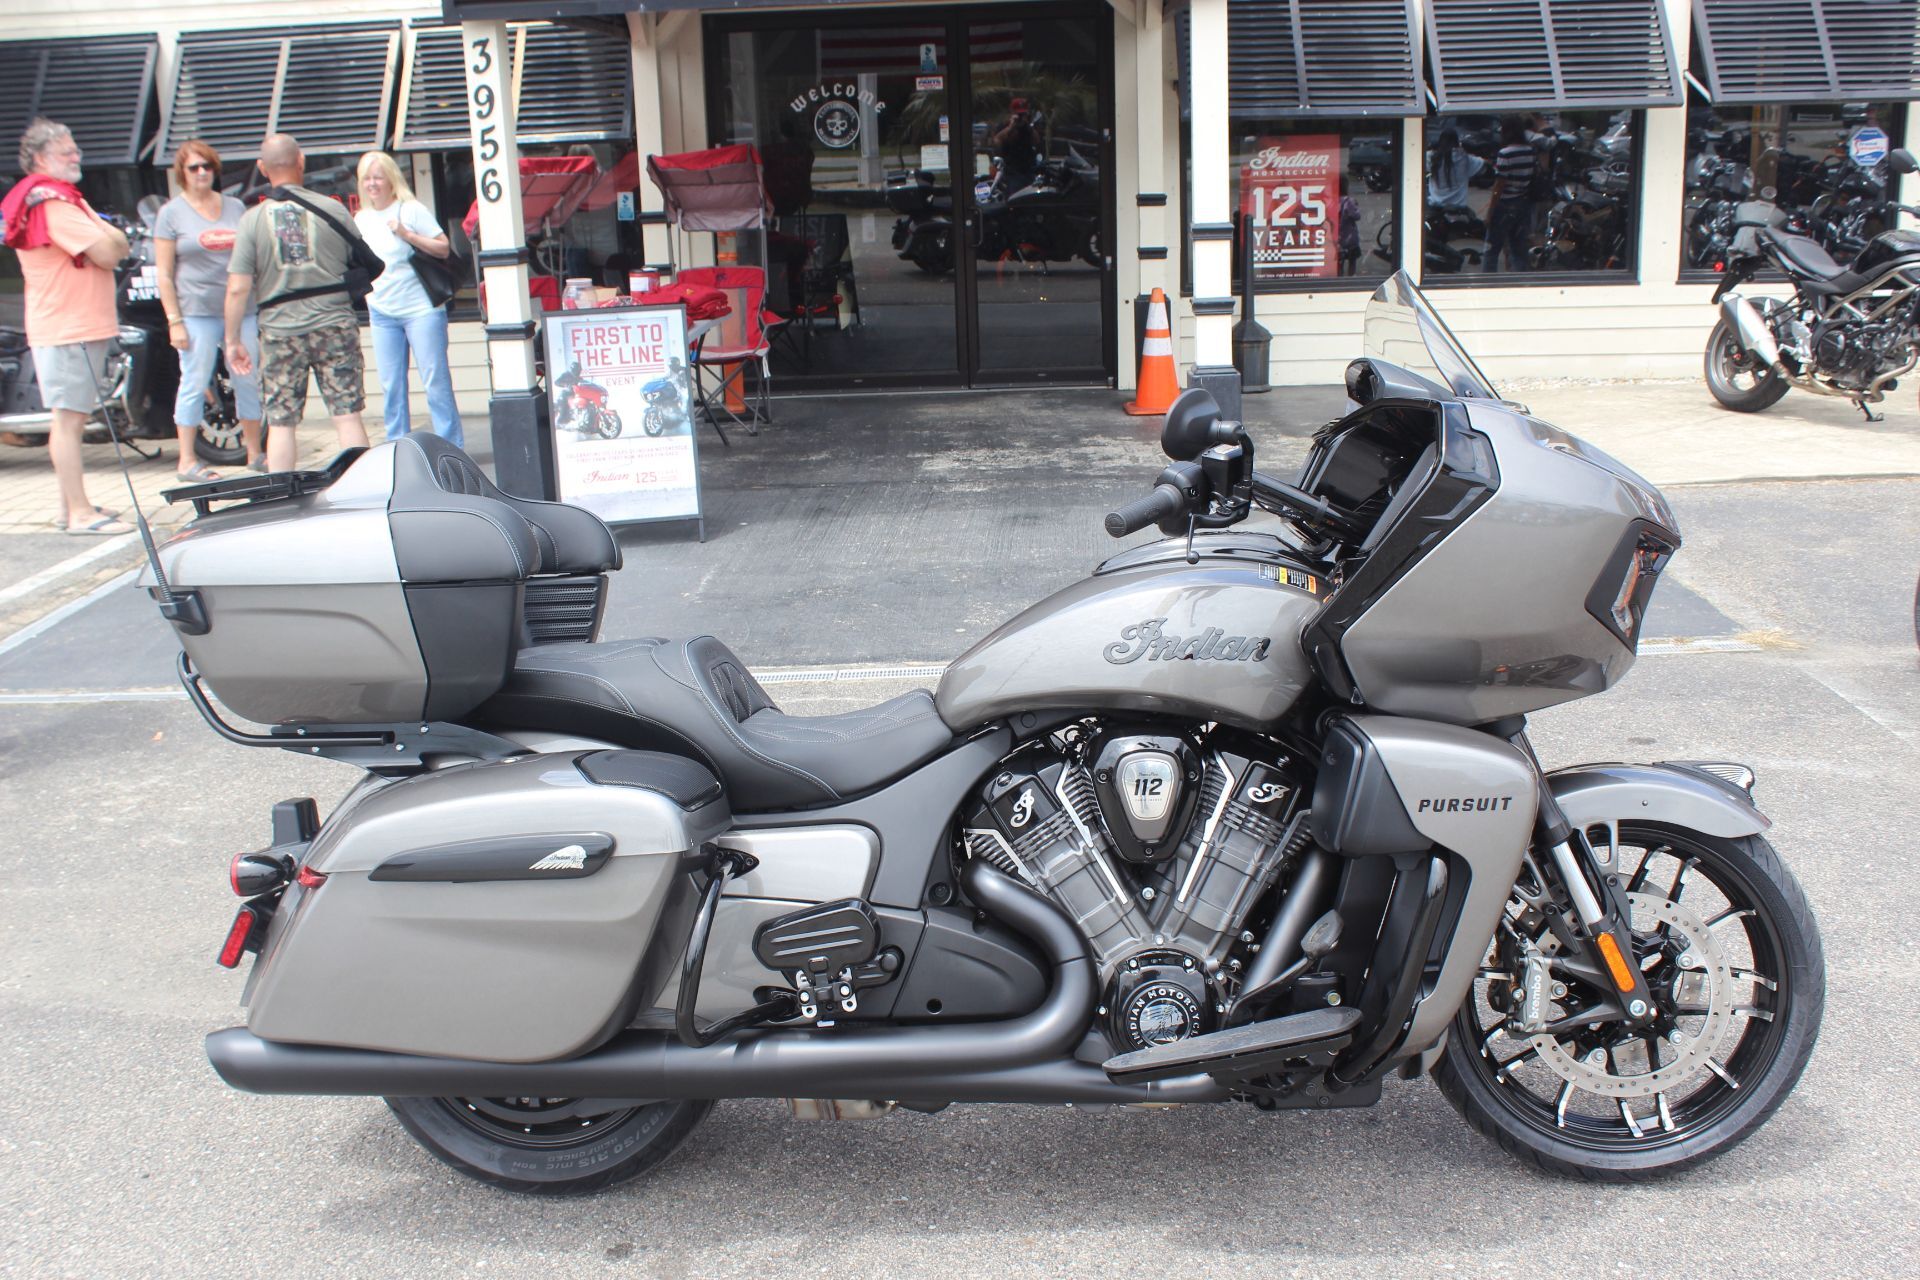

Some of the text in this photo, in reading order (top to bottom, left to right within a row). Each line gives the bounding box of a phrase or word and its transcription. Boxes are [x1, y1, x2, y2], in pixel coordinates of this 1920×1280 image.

[790, 82, 886, 113] WELCOME
[472, 38, 502, 203] 3956
[1249, 146, 1330, 170] Indian
[1253, 169, 1327, 177] MOTORCYCLE
[1252, 185, 1326, 227] 125
[1253, 229, 1326, 247] YEARS
[637, 324, 663, 343] TO
[573, 345, 665, 367] THE LINE
[605, 376, 636, 387] EVENT
[636, 471, 657, 484] 125
[1102, 617, 1272, 665] Indian
[1134, 778, 1163, 796] 112
[1418, 797, 1512, 813] PURSUIT
[1529, 975, 1542, 1019] brembo
[1129, 988, 1200, 1045] INDIAN MOTORCYCL
